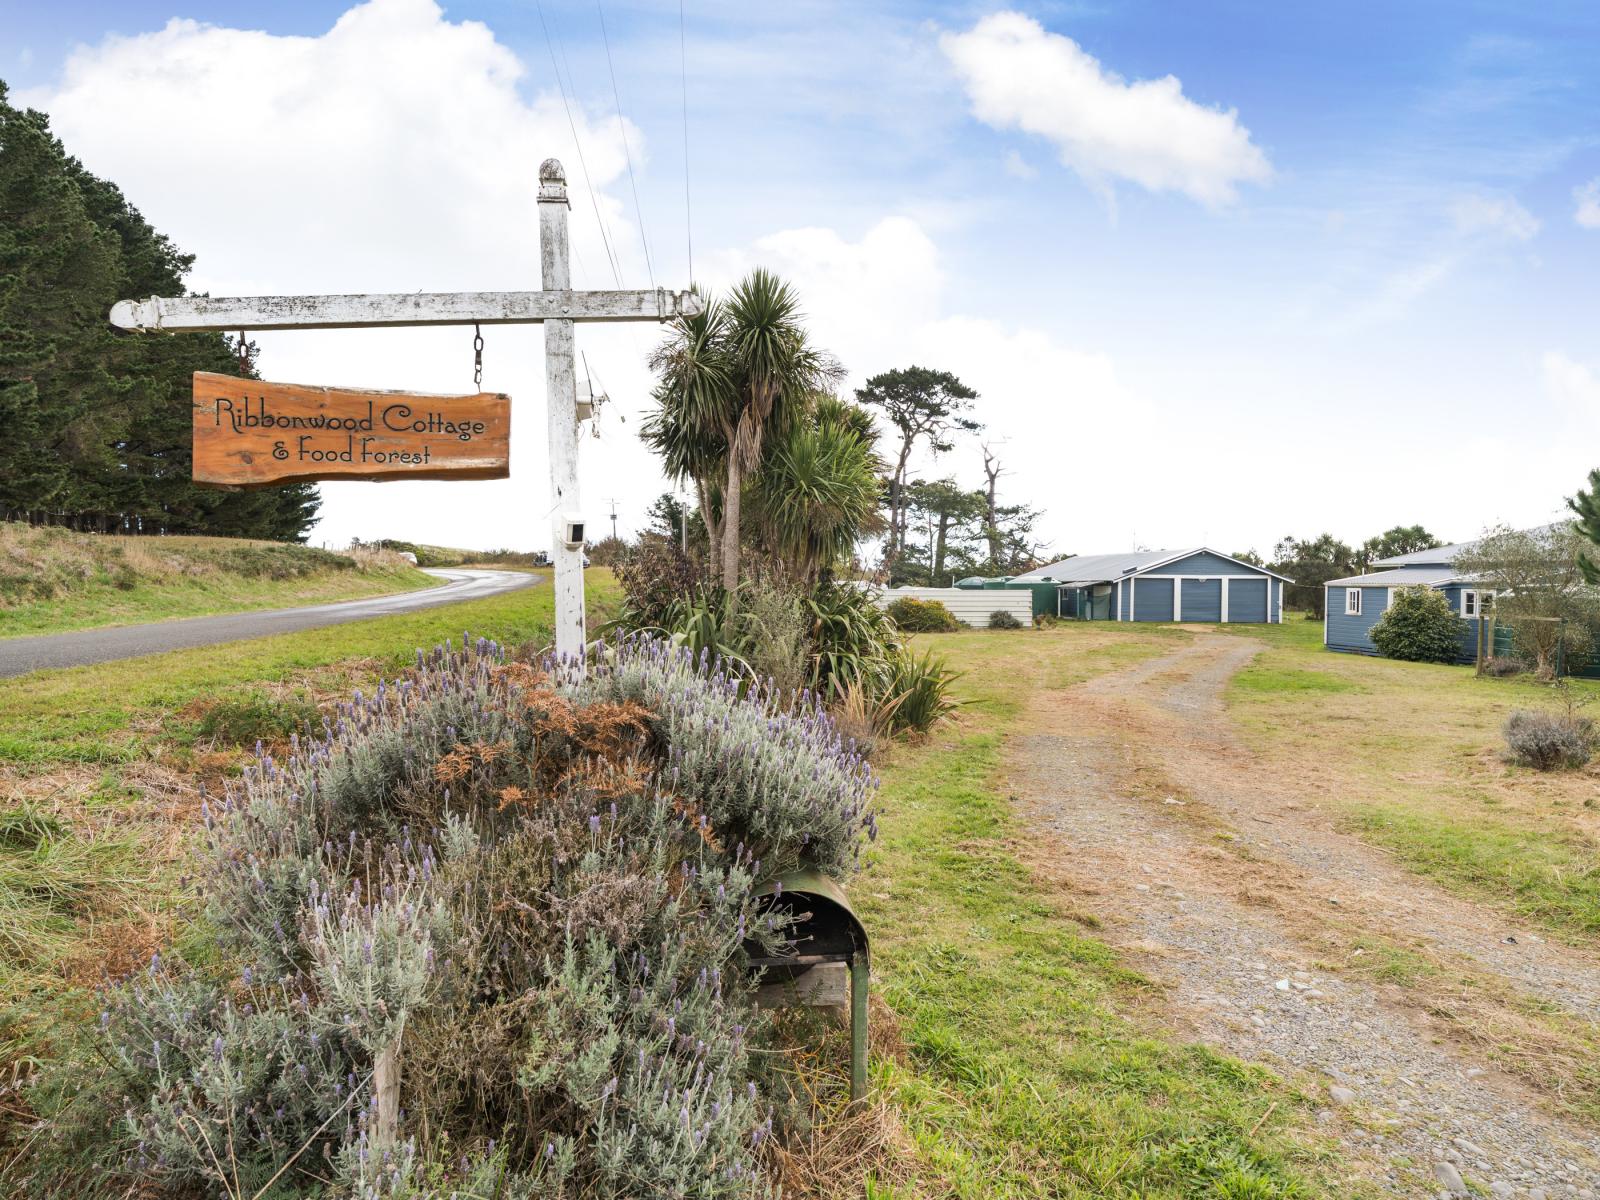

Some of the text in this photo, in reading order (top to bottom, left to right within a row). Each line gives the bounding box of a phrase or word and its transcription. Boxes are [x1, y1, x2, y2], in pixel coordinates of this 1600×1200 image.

[215, 397, 485, 441] Ribbonwood Cottage
[272, 435, 431, 464] & Food Forest
